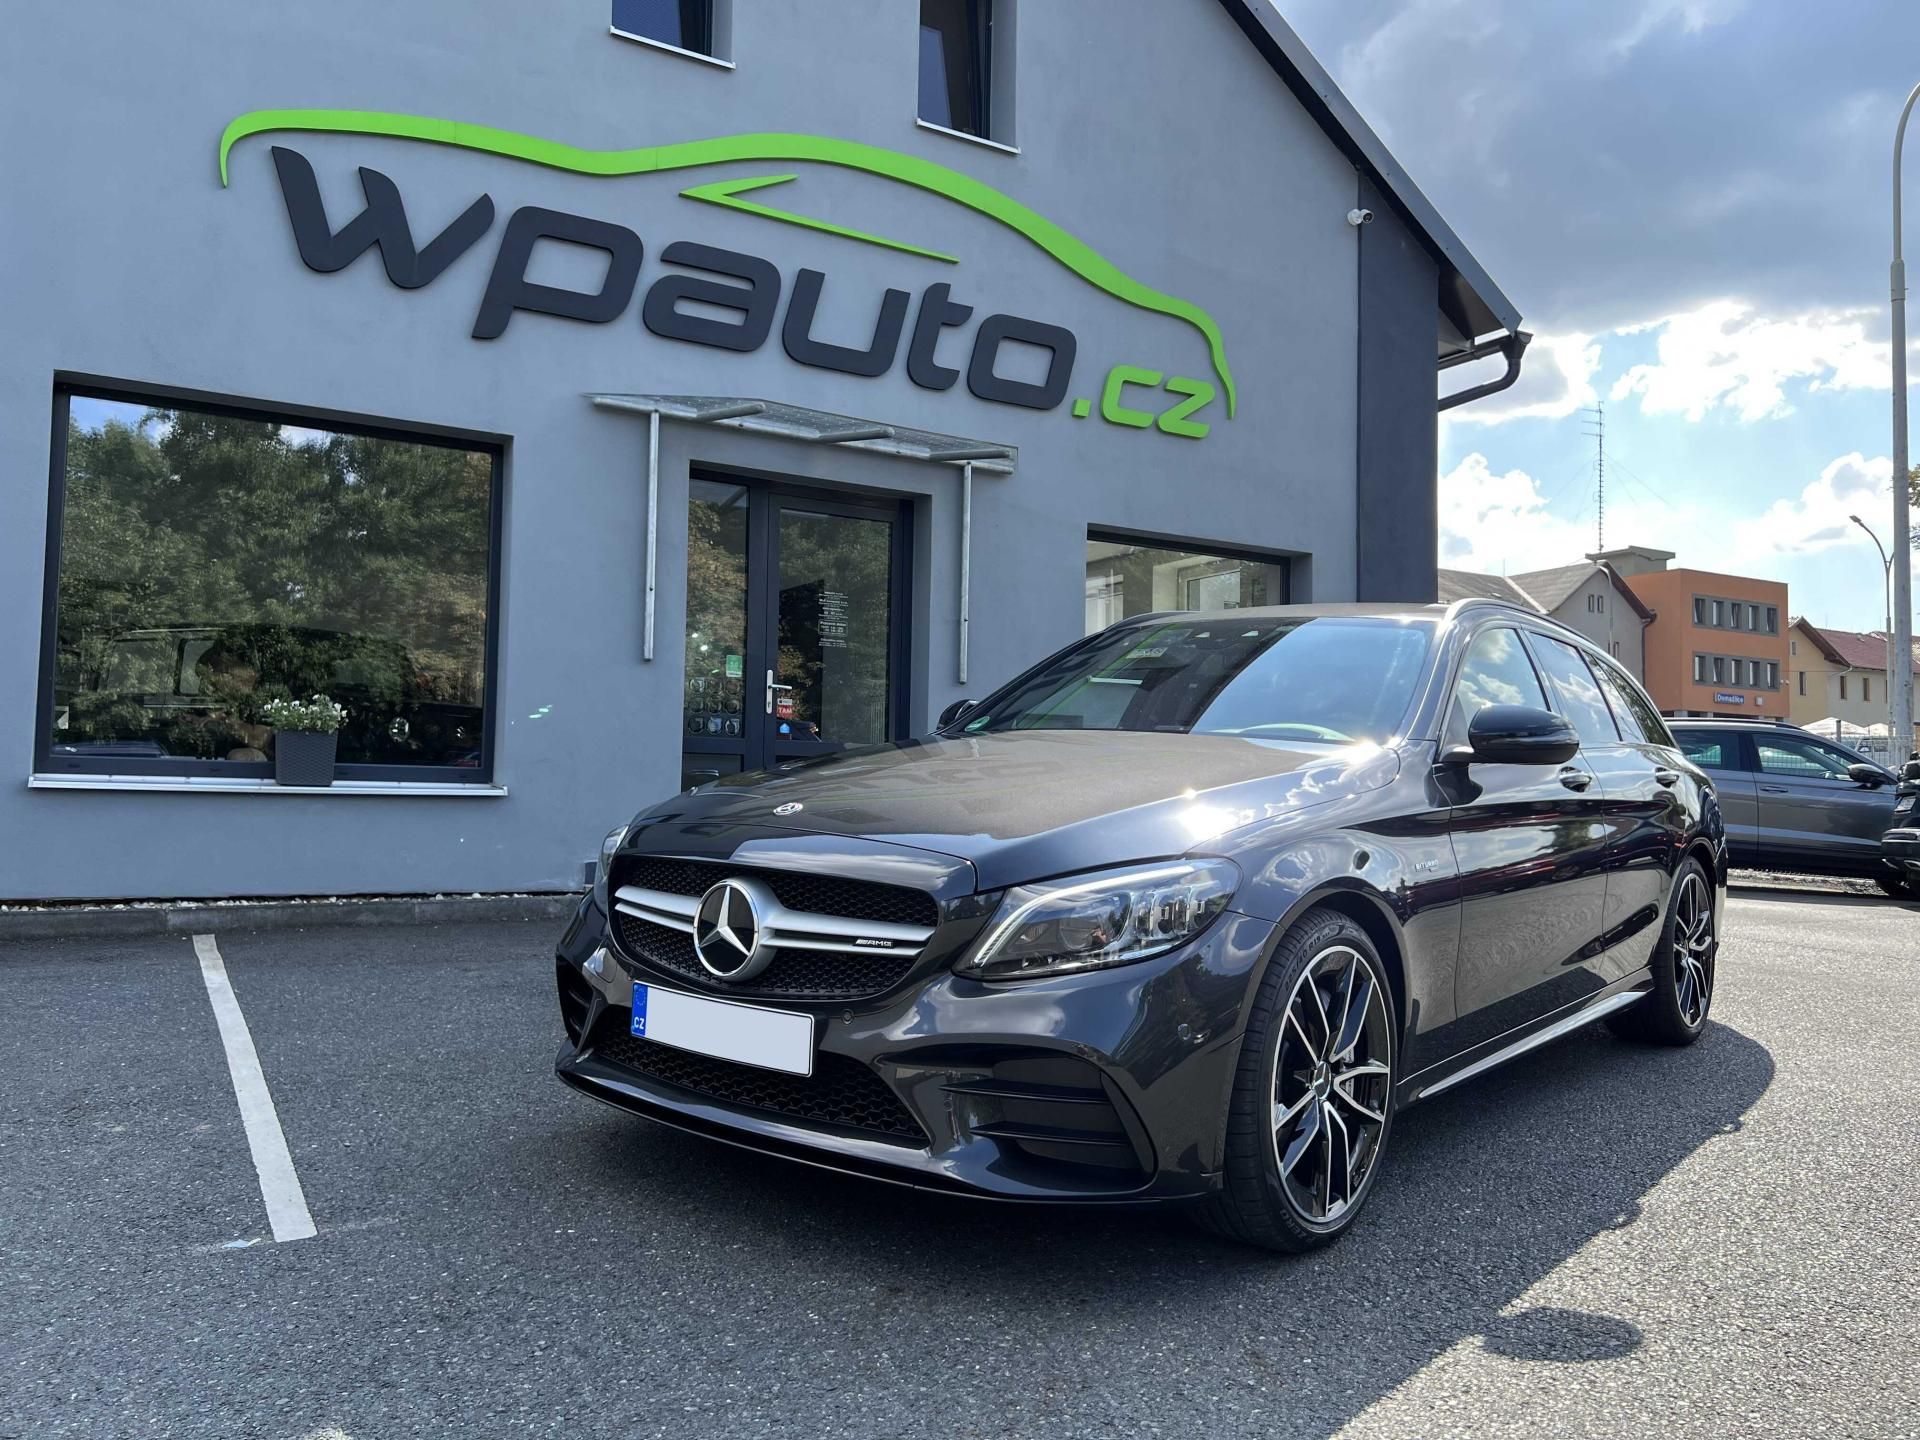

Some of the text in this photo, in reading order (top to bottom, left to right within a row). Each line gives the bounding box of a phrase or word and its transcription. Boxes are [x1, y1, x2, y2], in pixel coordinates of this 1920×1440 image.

[271, 146, 1216, 439] wpauto.cz
[863, 939, 892, 947] AMG
[634, 1016, 645, 1030] CZ
